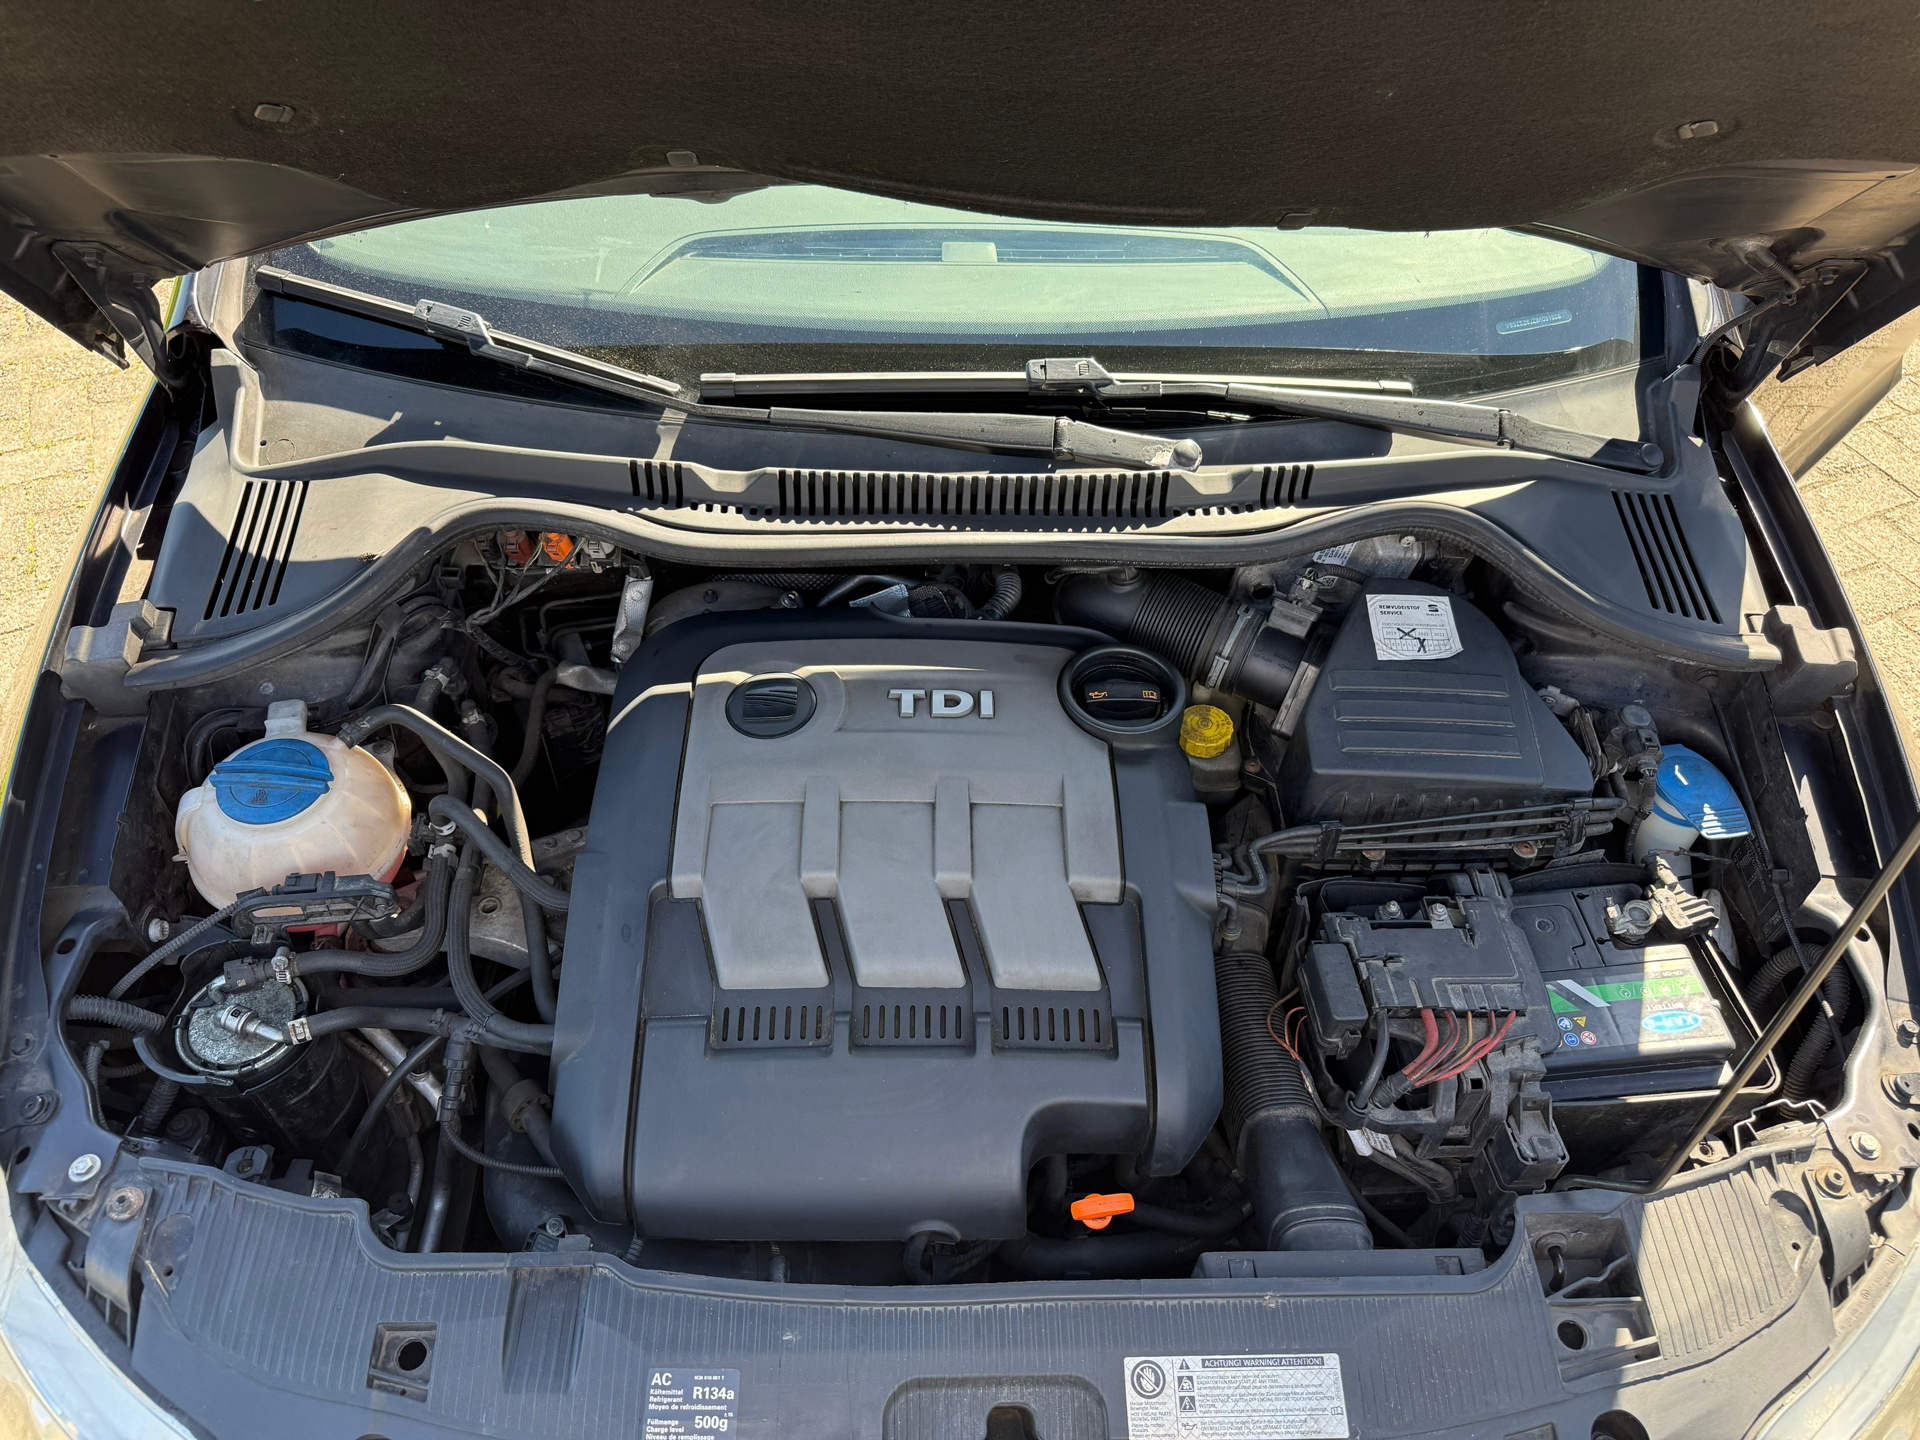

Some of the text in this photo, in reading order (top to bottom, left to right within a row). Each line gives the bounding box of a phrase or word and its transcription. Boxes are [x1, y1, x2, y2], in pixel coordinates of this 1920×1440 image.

[887, 688, 995, 718] TDI
[1204, 1359, 1241, 1367] ACHTUNG!
[651, 1373, 672, 1386] AC
[692, 1386, 734, 1399] R134a
[694, 1416, 728, 1431] 500g
